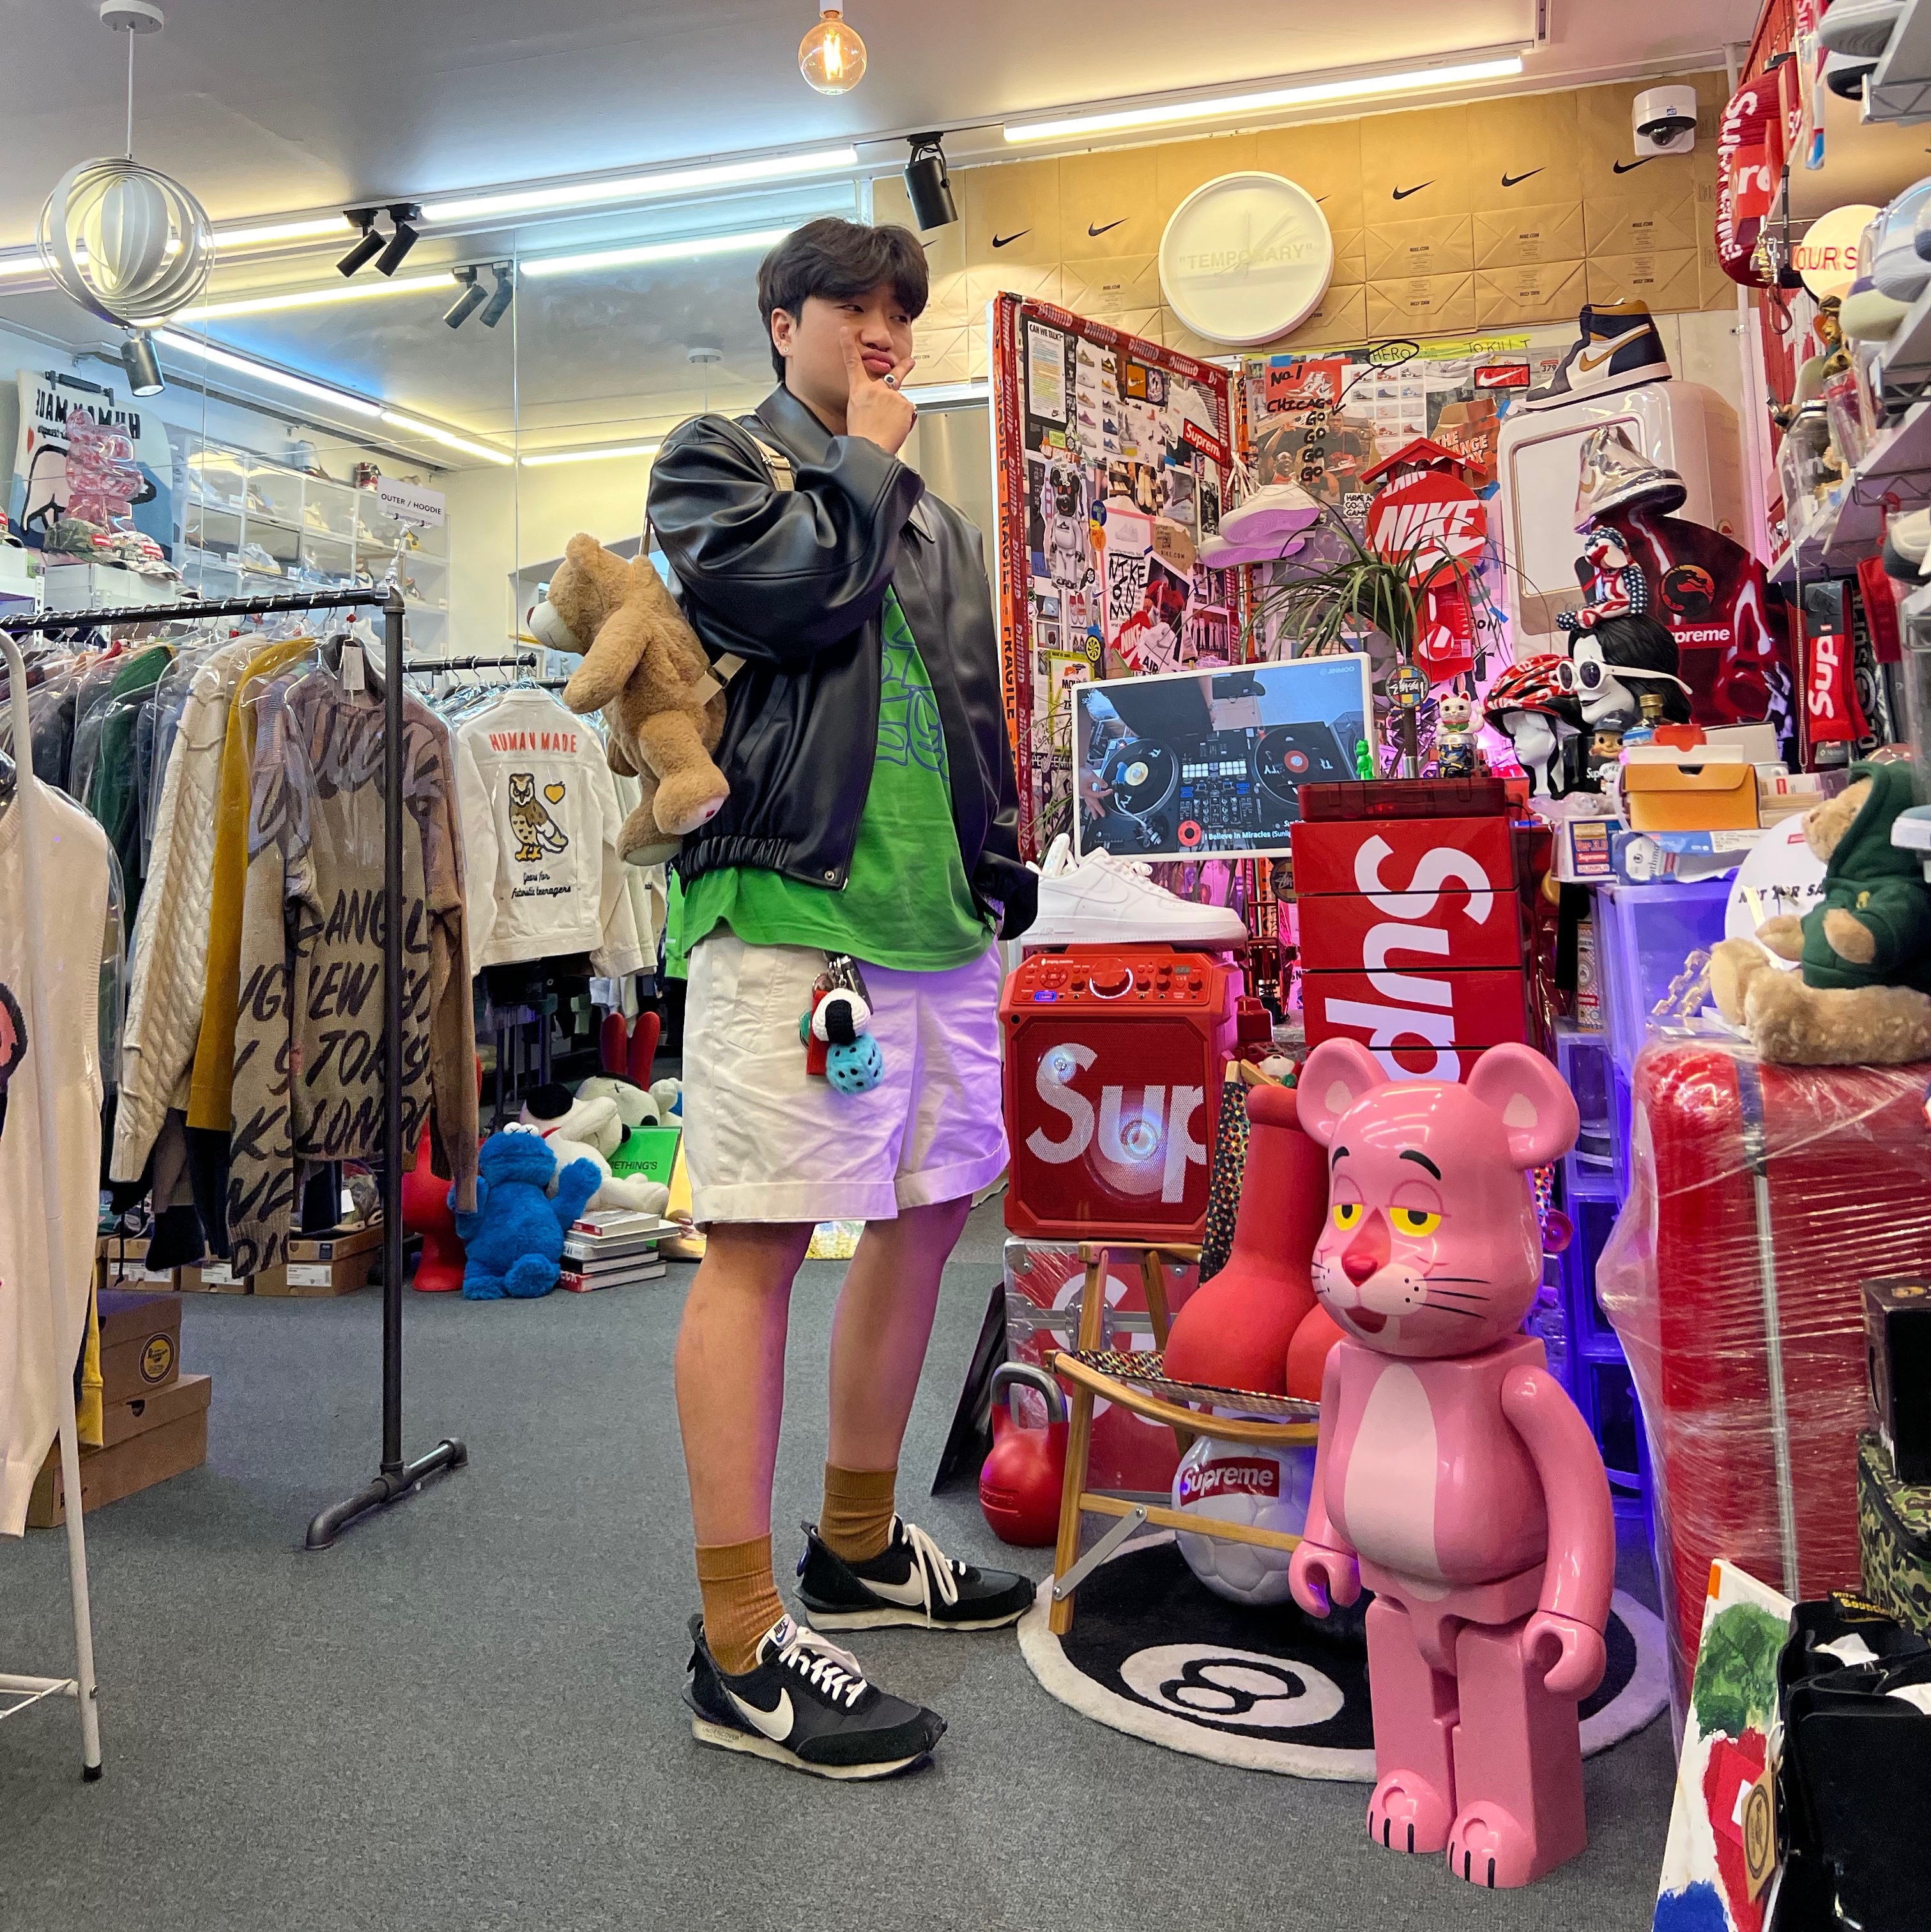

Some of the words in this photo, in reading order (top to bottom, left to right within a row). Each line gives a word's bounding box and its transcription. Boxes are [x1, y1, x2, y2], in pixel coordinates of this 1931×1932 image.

[1029, 324, 1039, 335] CAN
[1040, 328, 1048, 336] WE
[1372, 347, 1411, 362] HERO
[1541, 363, 1557, 372] 379
[1267, 397, 1333, 413] CHICAGO
[1306, 410, 1325, 426] GO
[1185, 422, 1220, 459] Suprem
[1304, 427, 1326, 445] GO
[1436, 431, 1459, 447] THE
[1302, 447, 1325, 463] GO
[1301, 466, 1324, 482] GO
[381, 493, 406, 505] OUTER
[413, 502, 441, 515] HOODIE
[1371, 499, 1480, 553] NIKE
[1161, 550, 1185, 559] NIKE.COM
[1109, 556, 1149, 589] NIKE
[1112, 583, 1135, 605] ON
[1110, 602, 1134, 624] MY
[1327, 666, 1355, 675] JINMOO
[489, 732, 536, 752] HUMAN
[541, 732, 577, 753] MADE
[1209, 832, 1233, 840] Believe
[1242, 831, 1271, 839] Miracles
[536, 885, 571, 898] teenagers
[1025, 1042, 1208, 1203] Sup
[1181, 1467, 1273, 1496] Supreme
[774, 1618, 786, 1636] NIKE
[703, 1726, 740, 1741] UNDERCOVER
